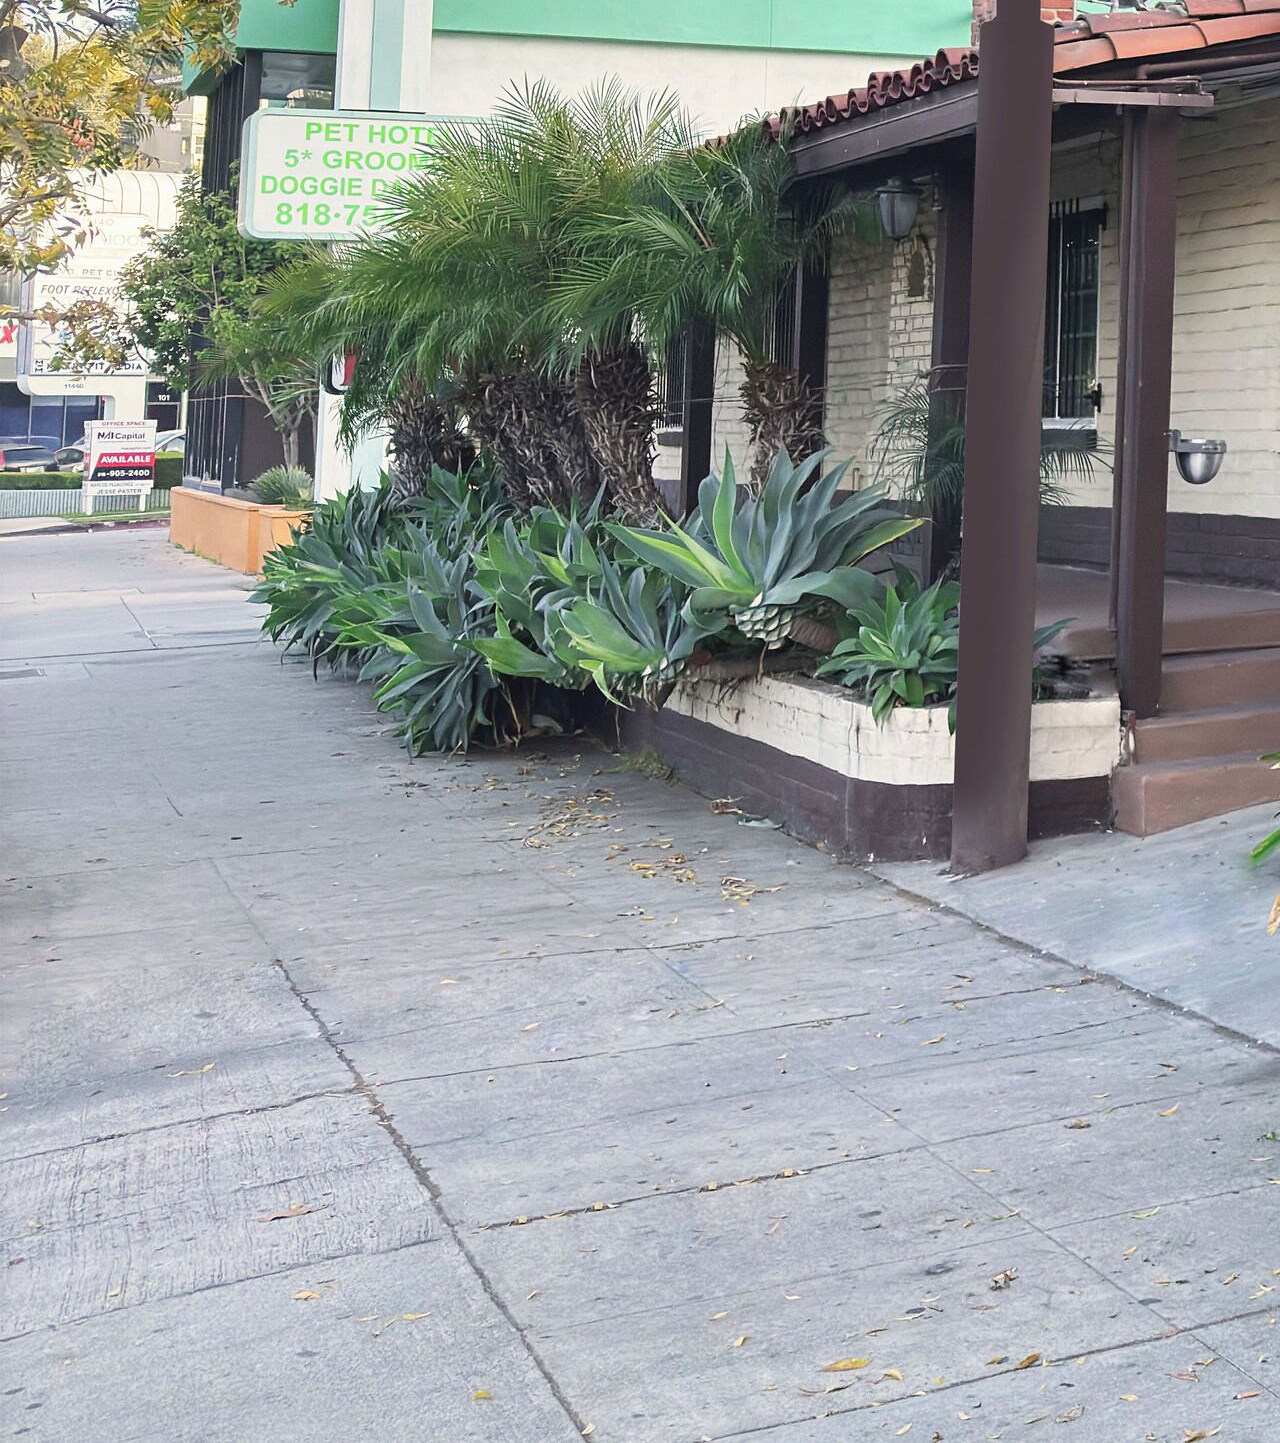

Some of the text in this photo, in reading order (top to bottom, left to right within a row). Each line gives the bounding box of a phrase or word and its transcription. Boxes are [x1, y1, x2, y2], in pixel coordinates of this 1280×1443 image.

[305, 122, 360, 143] PET
[260, 175, 363, 197] DOGGIE
[41, 284, 70, 294] FOOT
[158, 394, 171, 402] 101
[97, 431, 146, 440] NAI Capital
[100, 455, 151, 463] AVAILABLE
